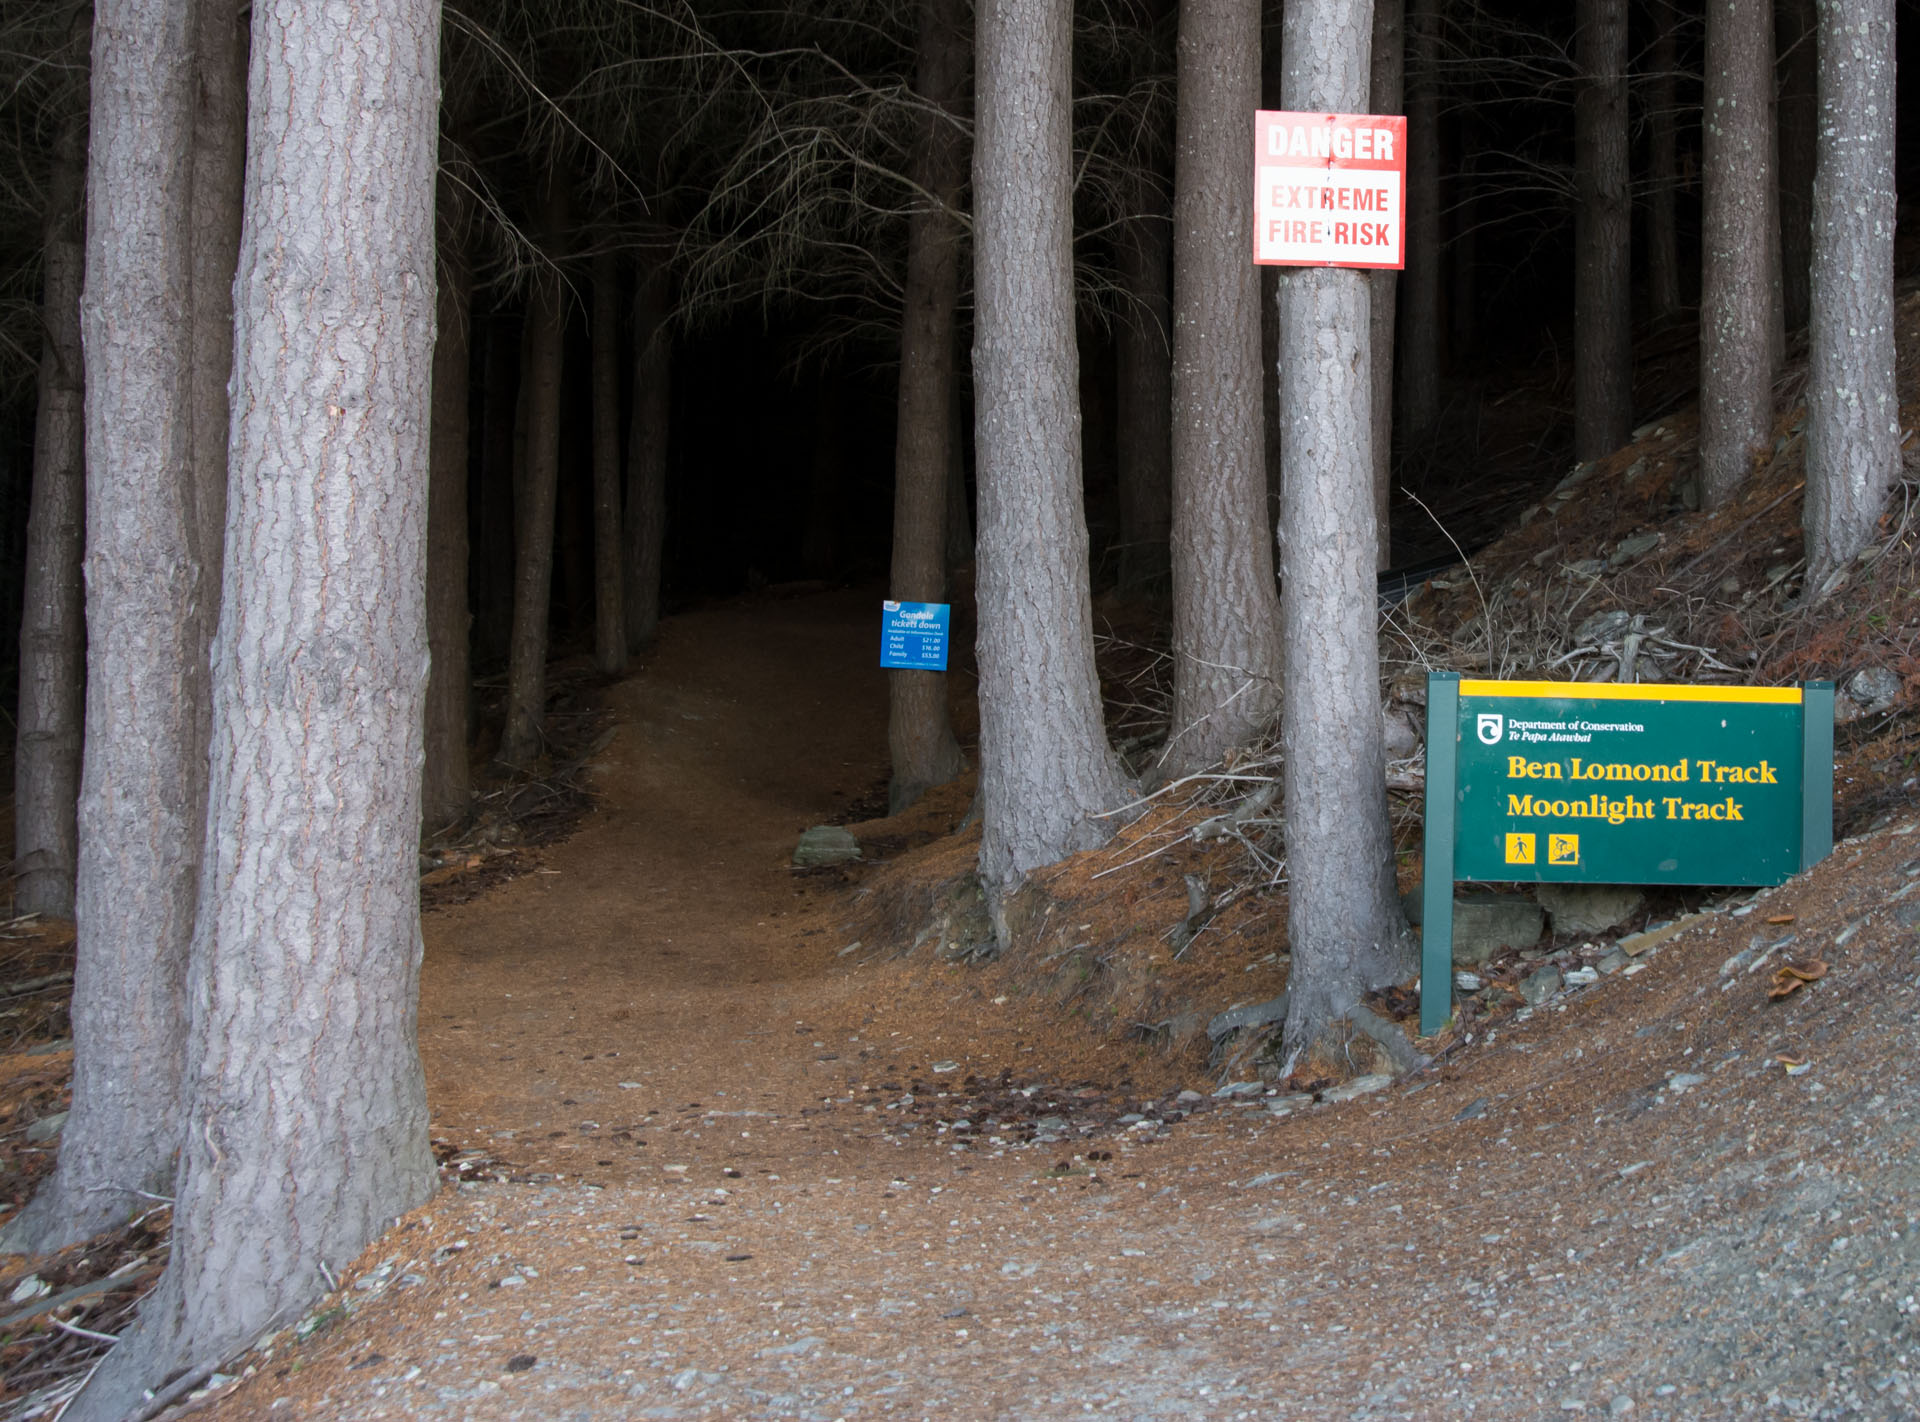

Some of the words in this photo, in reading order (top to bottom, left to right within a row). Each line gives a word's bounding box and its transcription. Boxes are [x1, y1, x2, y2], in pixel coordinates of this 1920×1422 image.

[1268, 125, 1394, 160] DANGER
[1272, 185, 1388, 211] EXTREME
[1269, 220, 1322, 243] FIRE
[1335, 222, 1389, 246] RISK
[891, 620, 917, 628] tickets
[919, 621, 940, 629] down
[900, 610, 934, 620] Gondola
[1509, 719, 1566, 732] Department
[1568, 720, 1579, 730] of
[1581, 722, 1644, 732] Conservation
[1509, 731, 1521, 741] Te
[1522, 732, 1546, 743] Papa
[1549, 732, 1591, 743] Atawhai
[1507, 756, 1562, 779] Ben
[1571, 758, 1689, 781] Lomond
[1697, 760, 1777, 784] Track
[1507, 794, 1654, 824] Moonlight
[1663, 797, 1743, 821] Track
